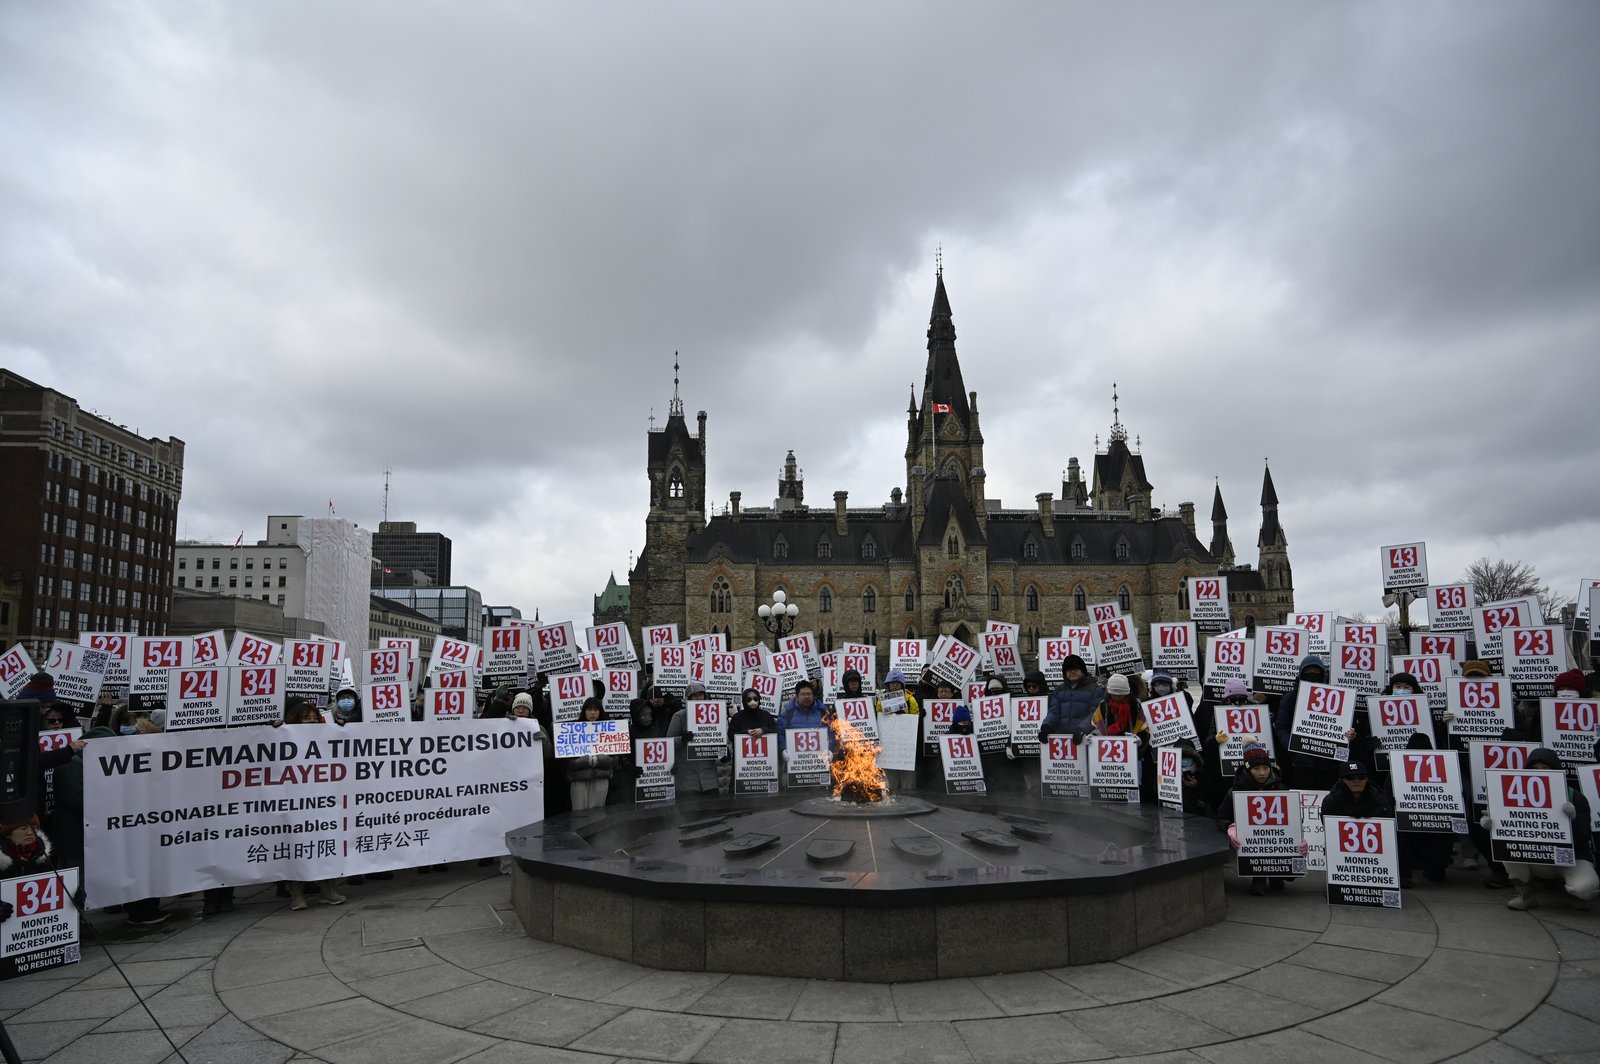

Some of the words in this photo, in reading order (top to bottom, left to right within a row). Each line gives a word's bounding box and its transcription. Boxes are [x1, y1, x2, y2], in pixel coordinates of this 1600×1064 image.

[1393, 548, 1414, 567] 43
[1199, 581, 1217, 598] 22
[1440, 588, 1463, 608] 36
[1488, 609, 1515, 632] 32
[496, 632, 516, 651] 11
[542, 628, 563, 649] 39
[599, 628, 619, 646] 20
[653, 628, 669, 645] 62
[1102, 621, 1123, 642] 13
[1163, 627, 1184, 646] 70
[242, 640, 269, 665] 25
[442, 643, 466, 662] 22
[901, 642, 916, 656] 16
[1050, 641, 1069, 660] 39
[1218, 642, 1241, 664] 68
[1270, 632, 1295, 655] 53
[1519, 631, 1549, 655] 23
[148, 642, 178, 666] 54
[297, 644, 319, 666] 31
[374, 652, 396, 674] 39
[664, 648, 682, 666] 39
[714, 655, 733, 672] 36
[778, 654, 796, 672] 30
[950, 645, 971, 667] 30
[998, 649, 1014, 665] 32
[1345, 647, 1371, 670] 28
[0, 654, 21, 678] 29
[1408, 660, 1436, 681] 40
[59, 674, 87, 684] MONTHS
[184, 671, 213, 698] 24
[244, 670, 272, 695] 34
[562, 678, 584, 698] 40
[612, 672, 629, 691] 39
[376, 686, 398, 708] 53
[439, 692, 459, 714] 19
[1312, 688, 1340, 714] 30
[1464, 683, 1495, 707] 65
[698, 704, 717, 724] 36
[848, 702, 866, 719] 20
[935, 703, 953, 721] 34
[983, 699, 1002, 719] 55
[1020, 701, 1038, 721] 34
[1151, 700, 1177, 722] 34
[1384, 700, 1414, 725] 90
[1560, 703, 1593, 730] 40
[561, 722, 587, 734] STOP
[592, 721, 615, 732] THE
[1231, 710, 1256, 733] 30
[647, 742, 664, 762] 39
[746, 738, 764, 757] 11
[797, 732, 818, 751] 35
[952, 738, 970, 758] 51
[1053, 739, 1073, 759] 31
[1102, 741, 1125, 762] 23
[99, 753, 151, 776] WE
[162, 741, 298, 771] DEMAND
[304, 740, 322, 759] A
[328, 737, 413, 758] TIMELY
[420, 732, 532, 754] DECISION
[1162, 753, 1175, 776] 42
[1488, 747, 1523, 769] 20
[222, 763, 347, 789] DELAYED
[355, 761, 385, 780] BY
[390, 758, 447, 777] IRCC
[1409, 756, 1441, 782] 71
[355, 787, 452, 805] PROCEDURAL
[457, 780, 528, 796] FAIRNESS
[1403, 794, 1435, 802] WAITING
[1508, 776, 1545, 807] 40
[107, 803, 239, 830] REASONABLE
[243, 796, 336, 813] TIMELINES
[355, 812, 400, 829] Équité
[404, 804, 490, 825] procédurale
[1252, 797, 1284, 824] 34
[1400, 802, 1417, 810] IRCC
[1417, 802, 1459, 810] RESPONSE
[1510, 811, 1548, 819] MONTHS
[160, 828, 219, 846] Délais
[225, 819, 337, 839] raisonnables
[1496, 829, 1516, 837] IRCC
[1518, 831, 1565, 839] RESPONSE
[1501, 820, 1539, 828] WAITING
[356, 829, 430, 853] 程序公平
[1344, 823, 1378, 852] 36
[247, 839, 336, 863] 给出时限
[1345, 857, 1379, 865] MONTHS
[1336, 865, 1371, 874] WAITING
[1351, 876, 1394, 884] RESPONSE
[22, 878, 59, 914] 34
[11, 927, 49, 941] WAITING
[51, 923, 68, 933] FOR
[21, 915, 59, 929] MONTHS
[6, 942, 26, 953] IRCC
[26, 931, 73, 947] RESPONSE
[15, 956, 25, 964] NO
[26, 948, 65, 963] TIMELINES
[18, 964, 29, 972] NO
[30, 957, 61, 969] RESULTS
